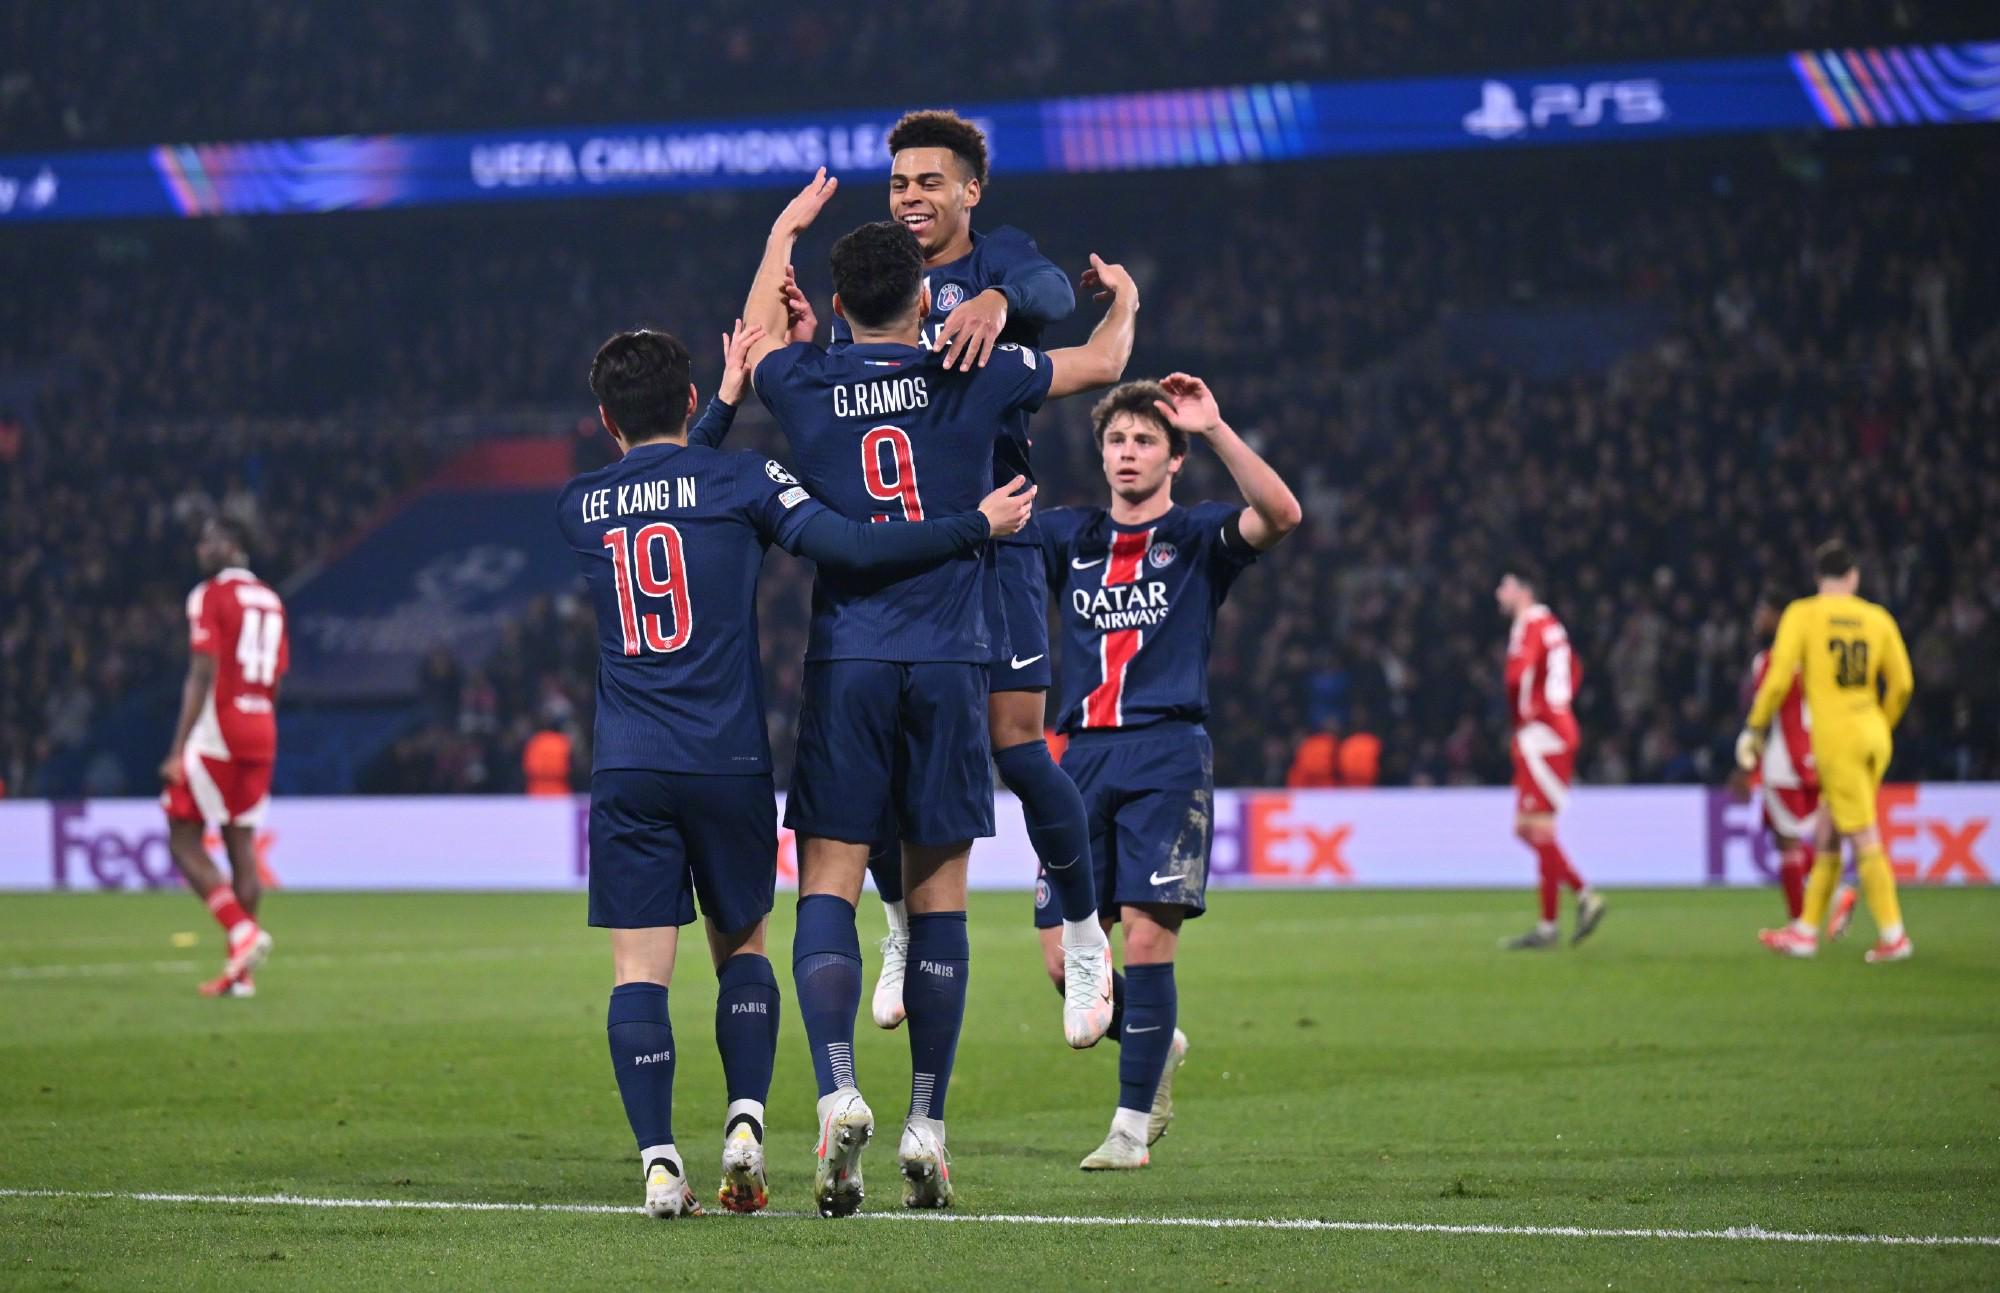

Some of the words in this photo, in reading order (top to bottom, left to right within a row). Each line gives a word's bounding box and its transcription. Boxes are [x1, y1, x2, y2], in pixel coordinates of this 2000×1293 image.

[1532, 79, 1666, 126] PS5
[470, 142, 577, 188] UEFA
[580, 127, 828, 184] CHAMPIONS
[834, 376, 929, 418] G.RAMOS
[861, 425, 925, 523] 9
[582, 488, 611, 524] LEE
[617, 480, 669, 516] KANG
[676, 476, 696, 508] IN
[603, 522, 693, 657] 19
[1072, 581, 1168, 620] QATAR
[1094, 607, 1169, 630] AIRWAYS
[1208, 794, 1354, 877] dEx
[1704, 784, 1990, 883] FEx
[919, 959, 954, 978] PARIS
[731, 1001, 767, 1015] PARIS
[634, 1050, 671, 1066] PARIS
